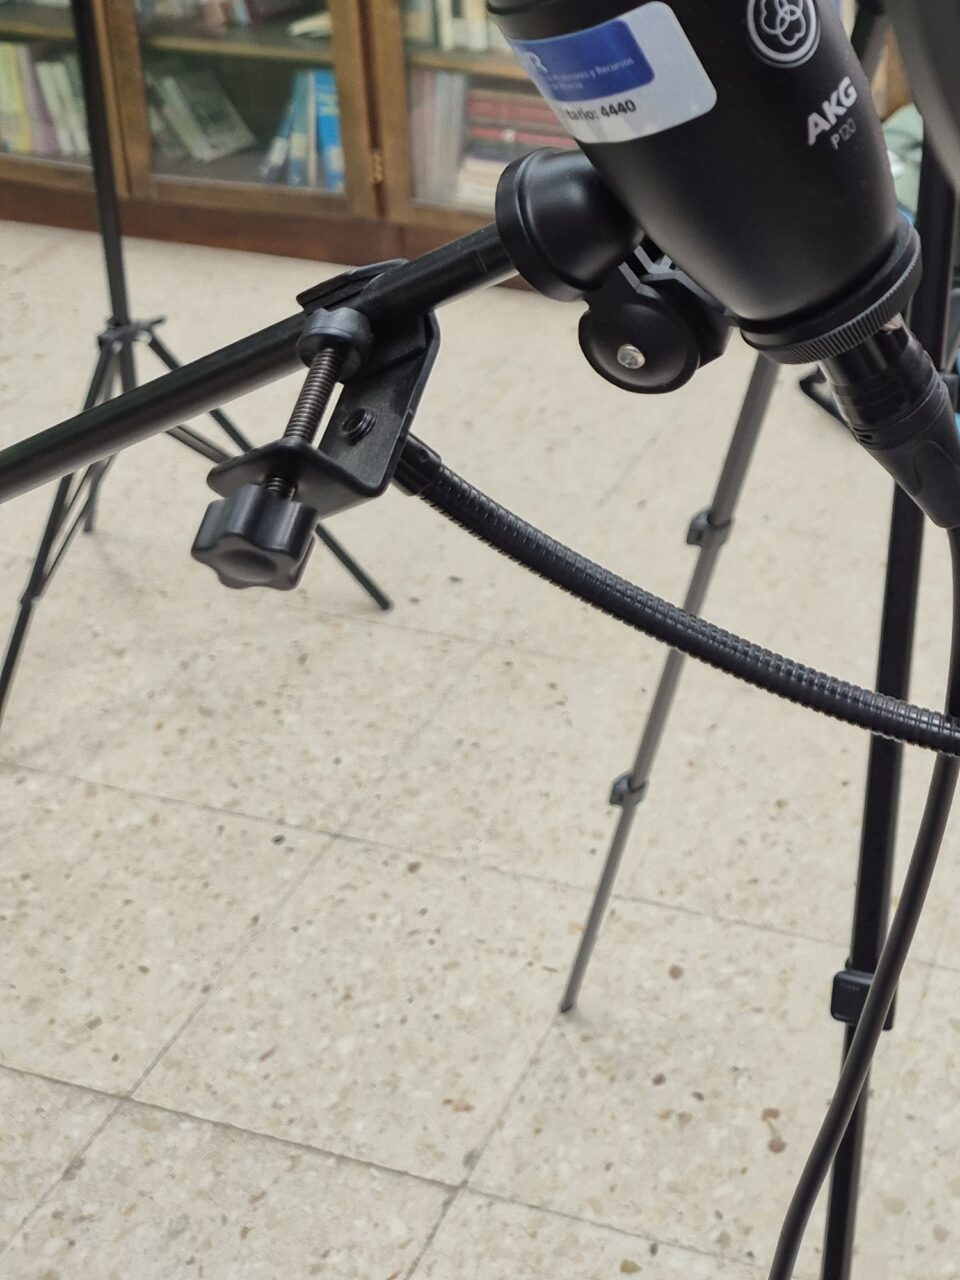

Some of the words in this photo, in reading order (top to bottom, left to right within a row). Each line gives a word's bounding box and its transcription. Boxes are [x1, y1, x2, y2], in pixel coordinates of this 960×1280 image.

[565, 108, 600, 121] tario:
[600, 98, 637, 118] 4440
[807, 75, 858, 146] AKG
